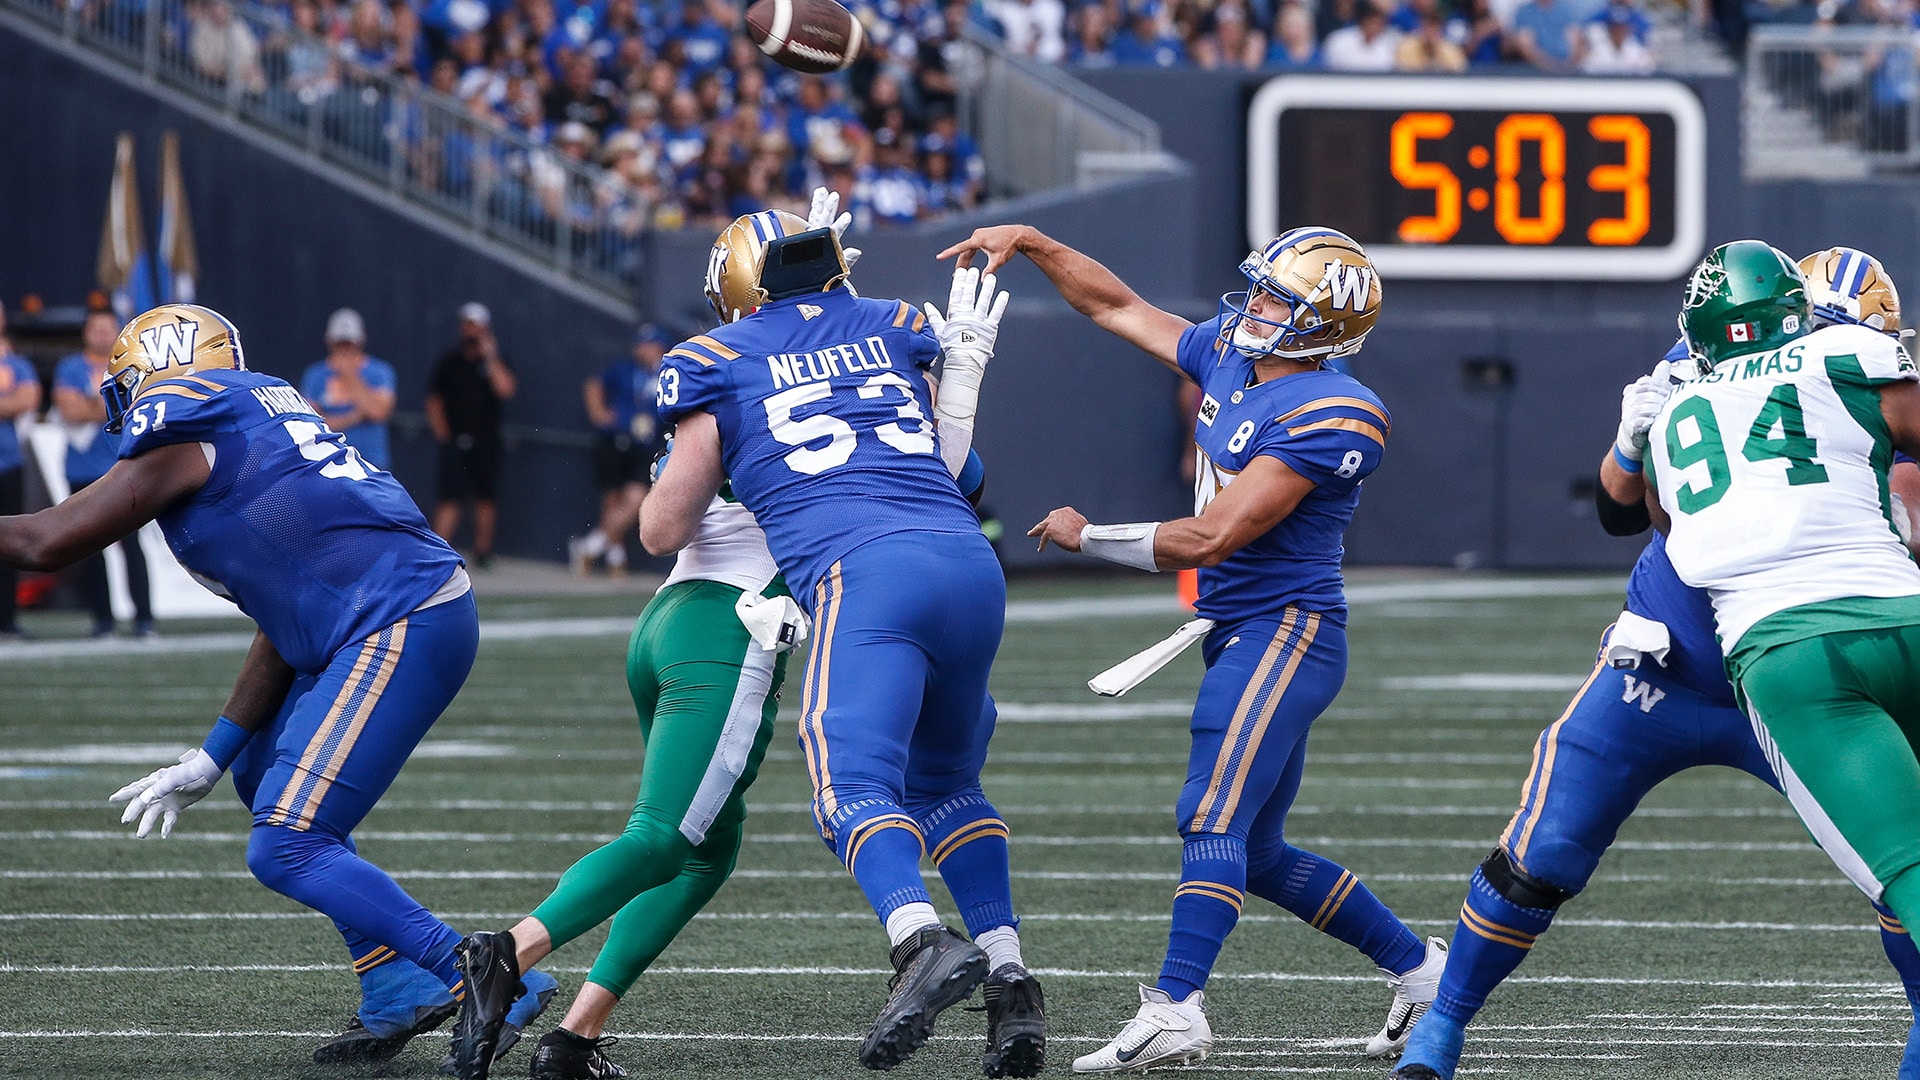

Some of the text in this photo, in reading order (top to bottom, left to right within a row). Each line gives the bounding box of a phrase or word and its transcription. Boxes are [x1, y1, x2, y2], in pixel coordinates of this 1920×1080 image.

[1390, 112, 1651, 245] 5:03
[1324, 261, 1373, 313] W
[140, 321, 199, 371] W
[767, 336, 892, 390] NEUFELD
[131, 403, 167, 437] 51
[763, 372, 936, 476] 53
[1228, 420, 1255, 453] 8
[1334, 450, 1363, 479] 8
[1666, 383, 1830, 516] 94
[1621, 673, 1667, 714] W
[1151, 1014, 1170, 1027] ALPHA
